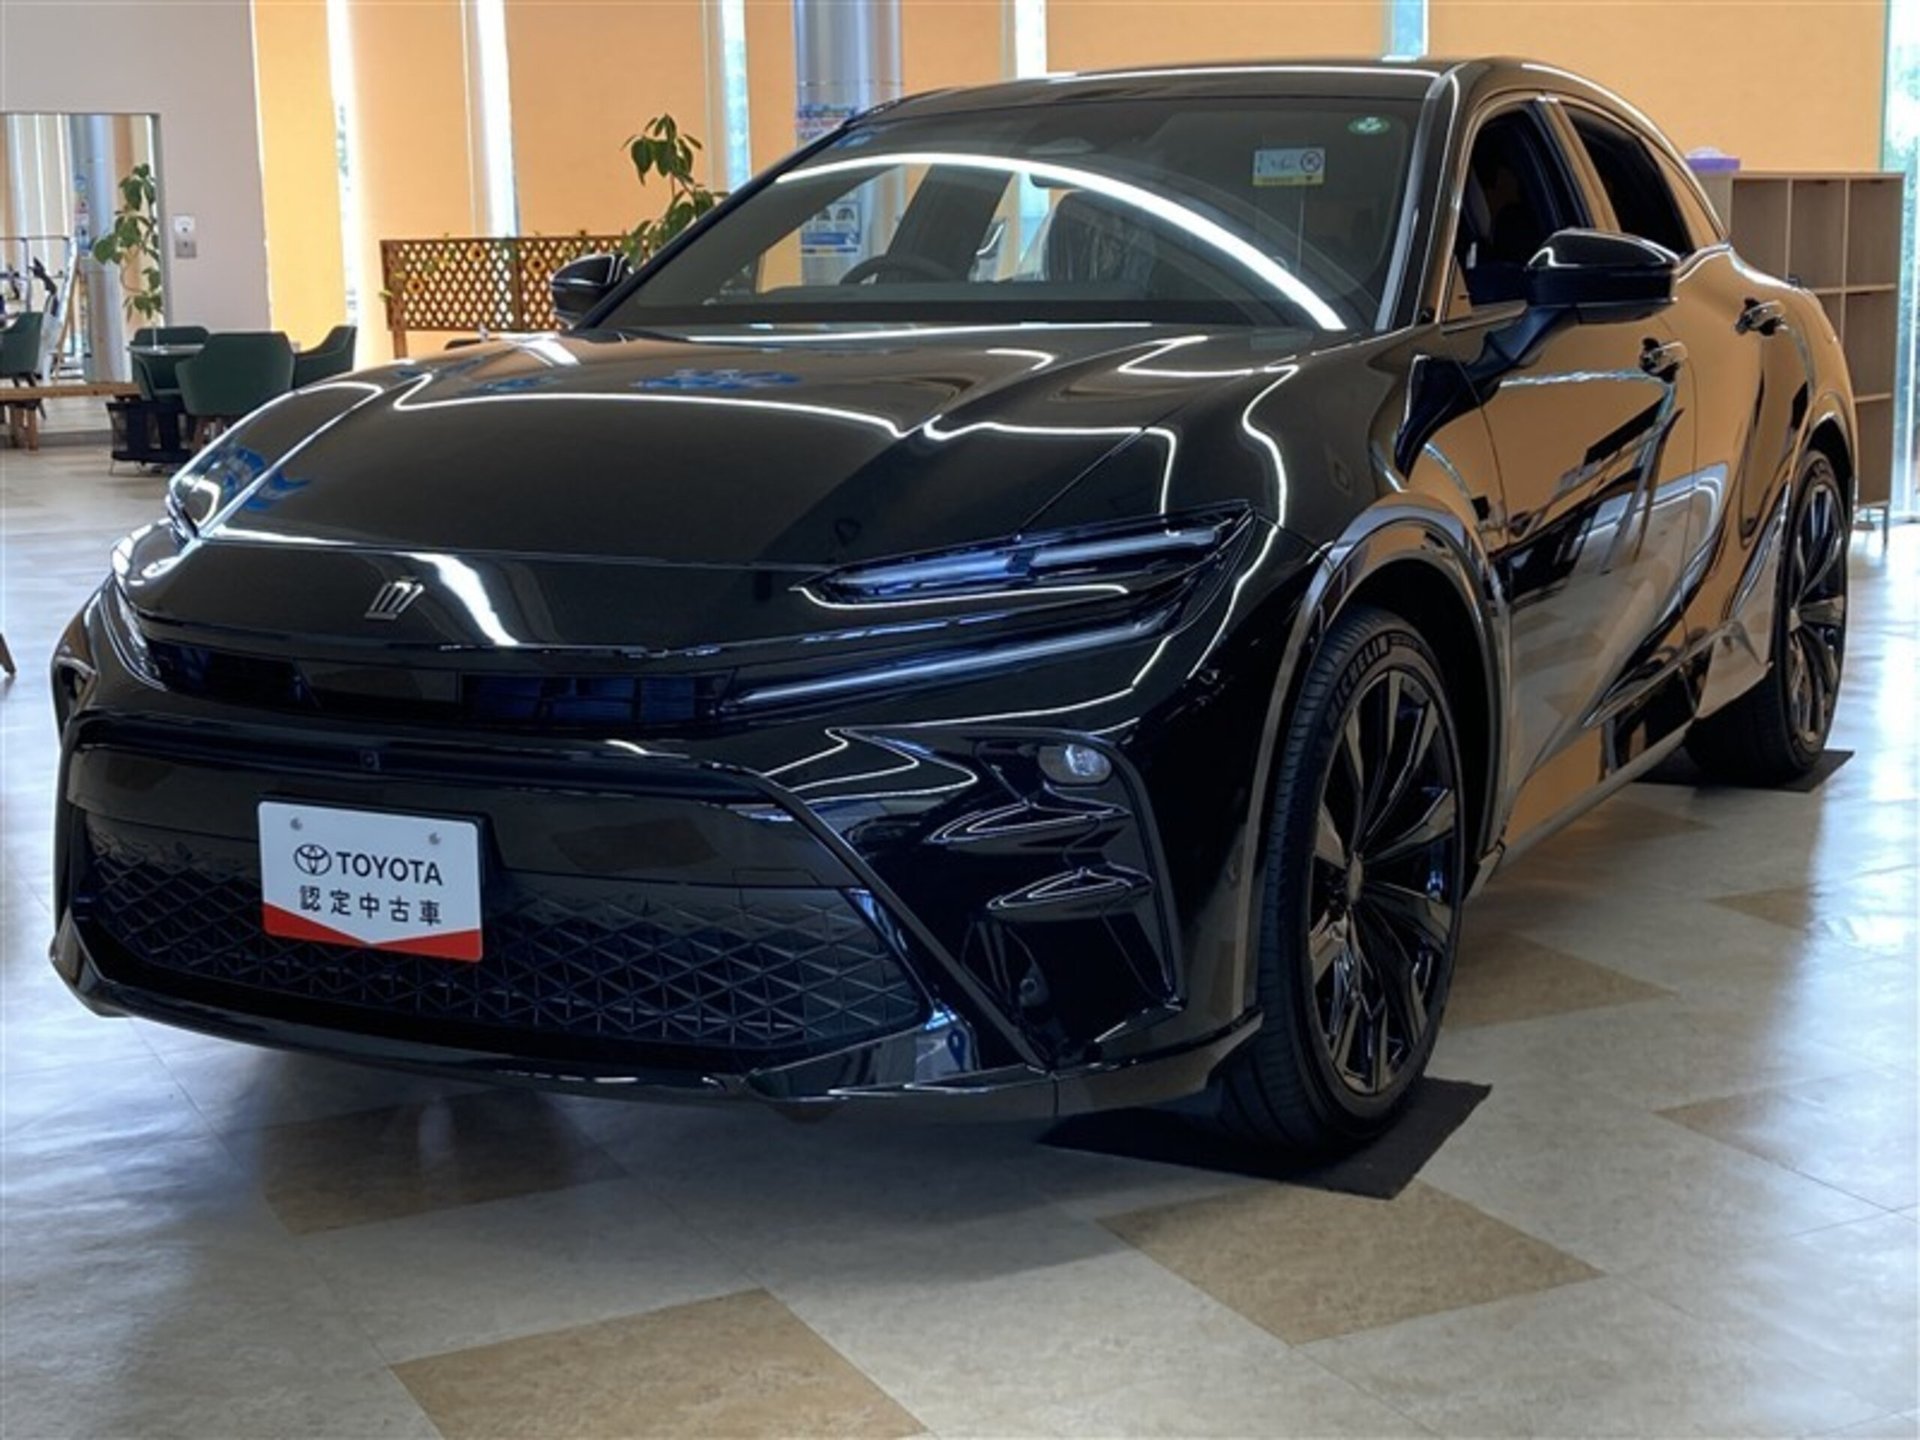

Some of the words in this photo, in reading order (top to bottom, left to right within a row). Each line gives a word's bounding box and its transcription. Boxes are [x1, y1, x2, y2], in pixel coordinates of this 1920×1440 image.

[336, 851, 443, 886] TOYOTA
[299, 885, 442, 926] 認定中古車
